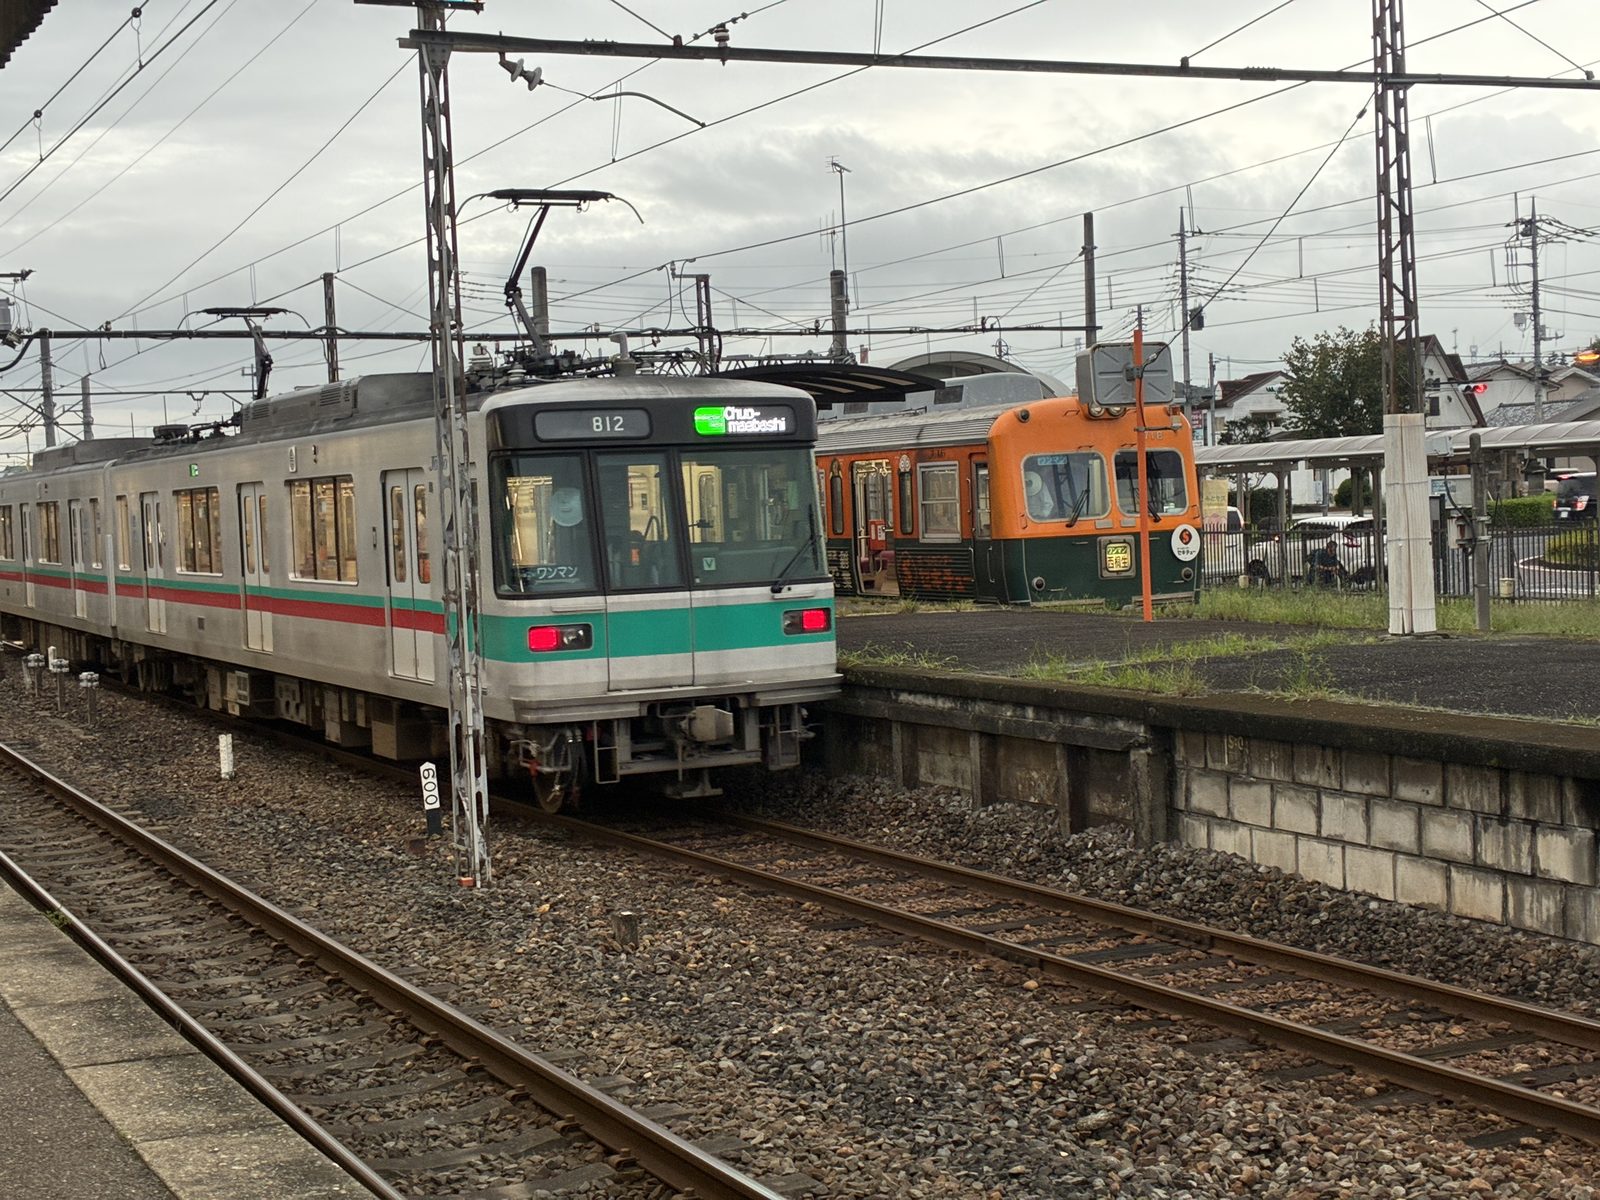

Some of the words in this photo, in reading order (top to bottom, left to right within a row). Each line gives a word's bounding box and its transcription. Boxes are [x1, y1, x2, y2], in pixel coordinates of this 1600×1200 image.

[592, 415, 625, 432] 812
[727, 416, 786, 433] maebashi
[705, 559, 713, 569] V
[536, 565, 578, 580] ワンマン
